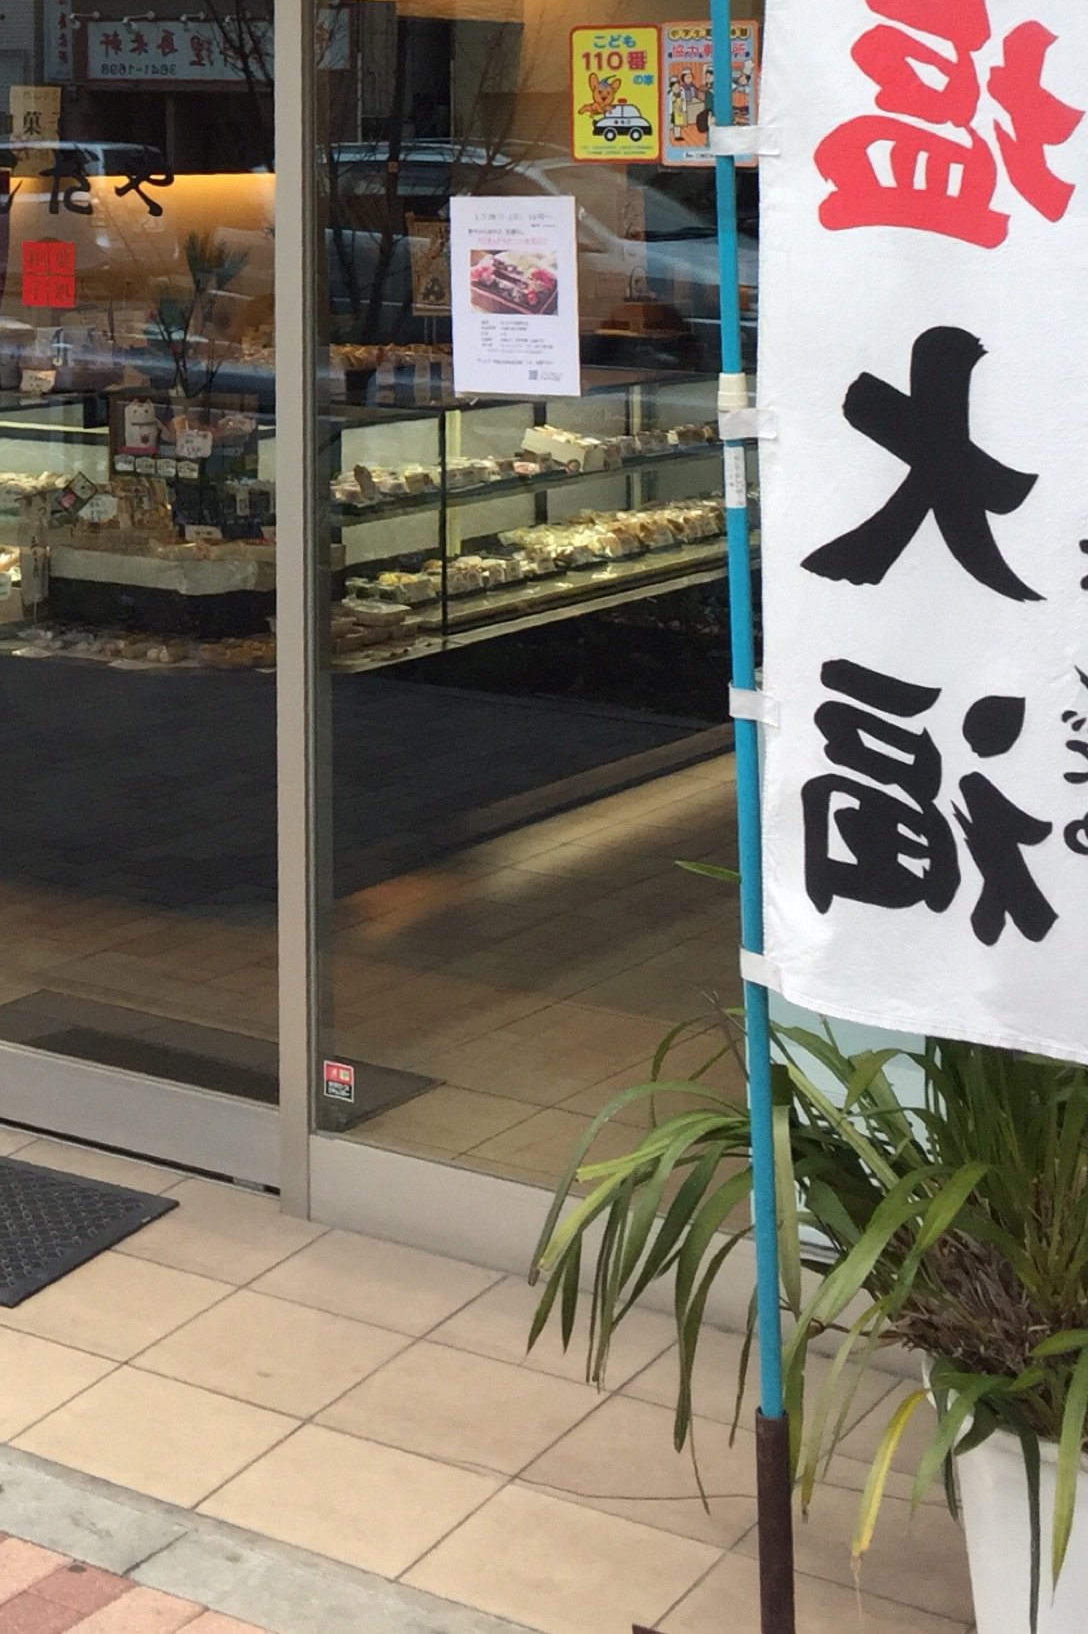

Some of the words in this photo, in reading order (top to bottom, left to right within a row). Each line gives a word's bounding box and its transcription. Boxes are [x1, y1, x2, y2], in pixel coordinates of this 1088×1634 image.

[593, 34, 636, 48] こども
[581, 50, 647, 71] 110番
